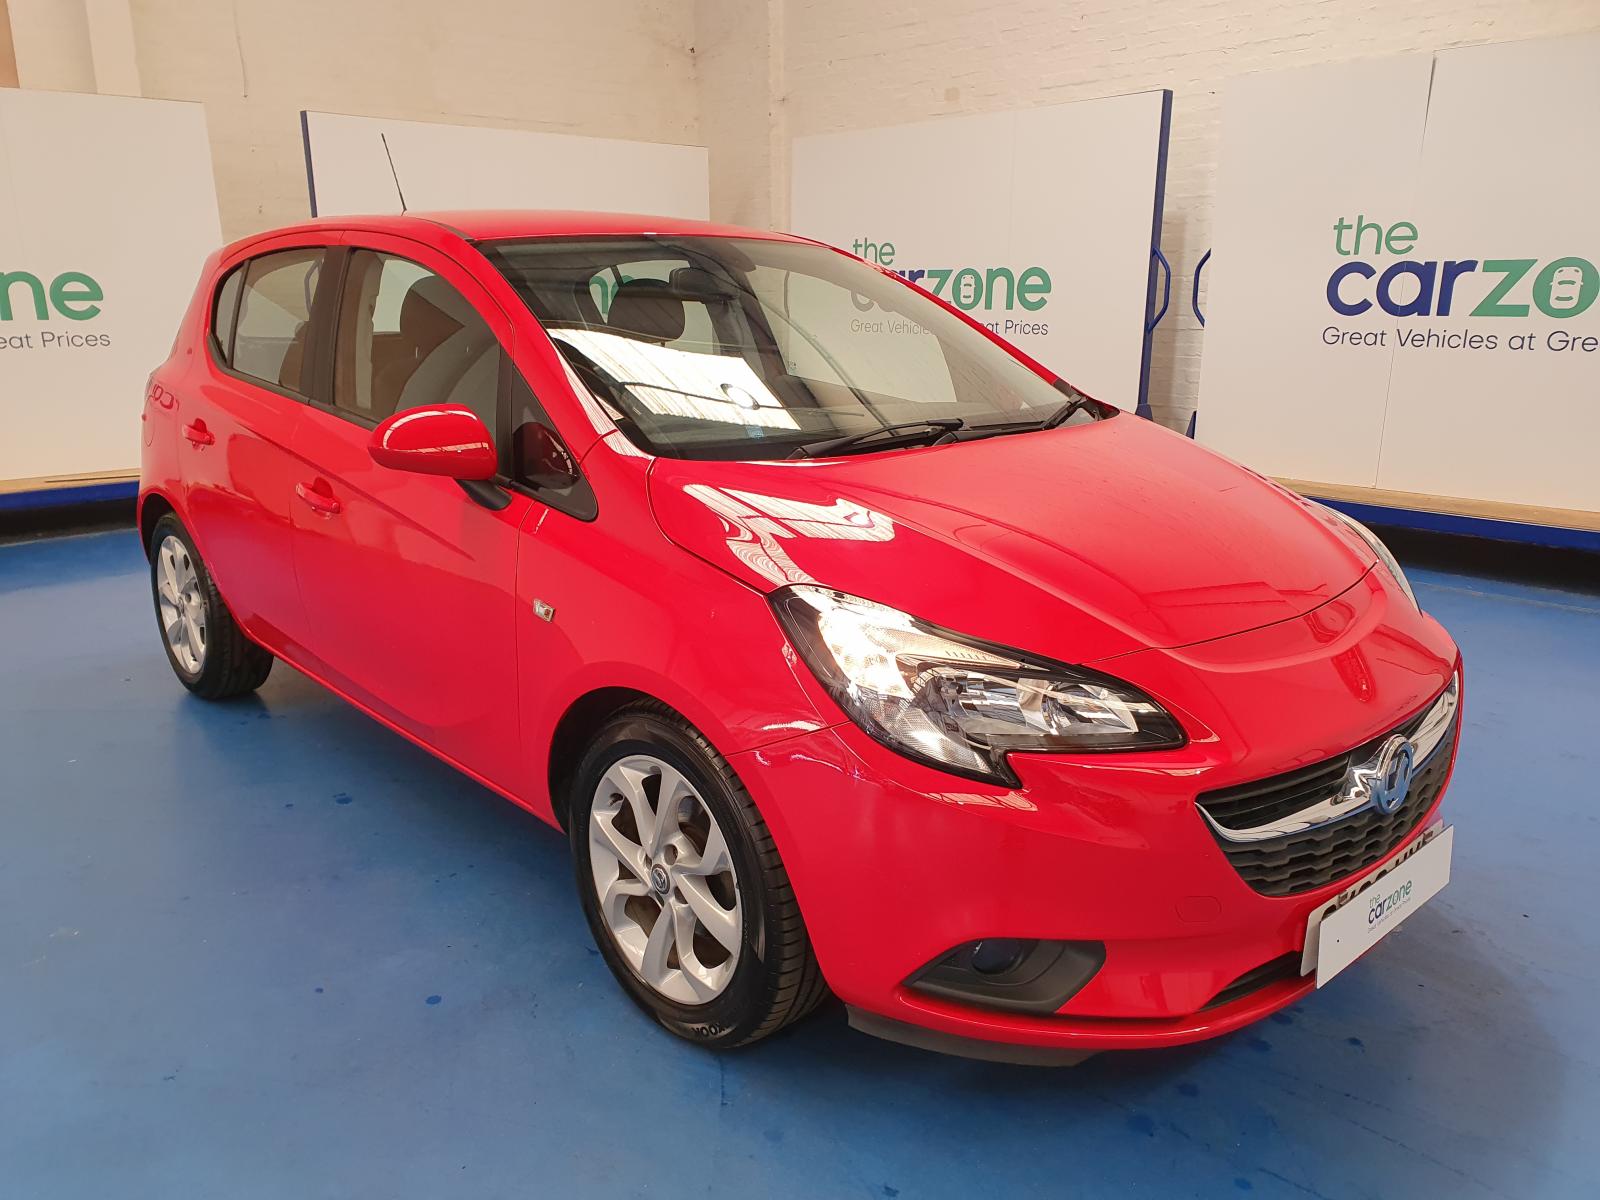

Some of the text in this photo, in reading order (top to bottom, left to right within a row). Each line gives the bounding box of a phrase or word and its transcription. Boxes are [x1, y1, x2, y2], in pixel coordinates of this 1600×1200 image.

[1333, 215, 1419, 256] the
[852, 237, 896, 266] the
[851, 266, 1052, 313] crzone
[41, 331, 112, 348] Prices
[851, 319, 883, 334] Great
[1004, 319, 1050, 336] Prices
[1322, 326, 1600, 353] Great Vehicles at Gre
[1368, 880, 1413, 925] carzone
